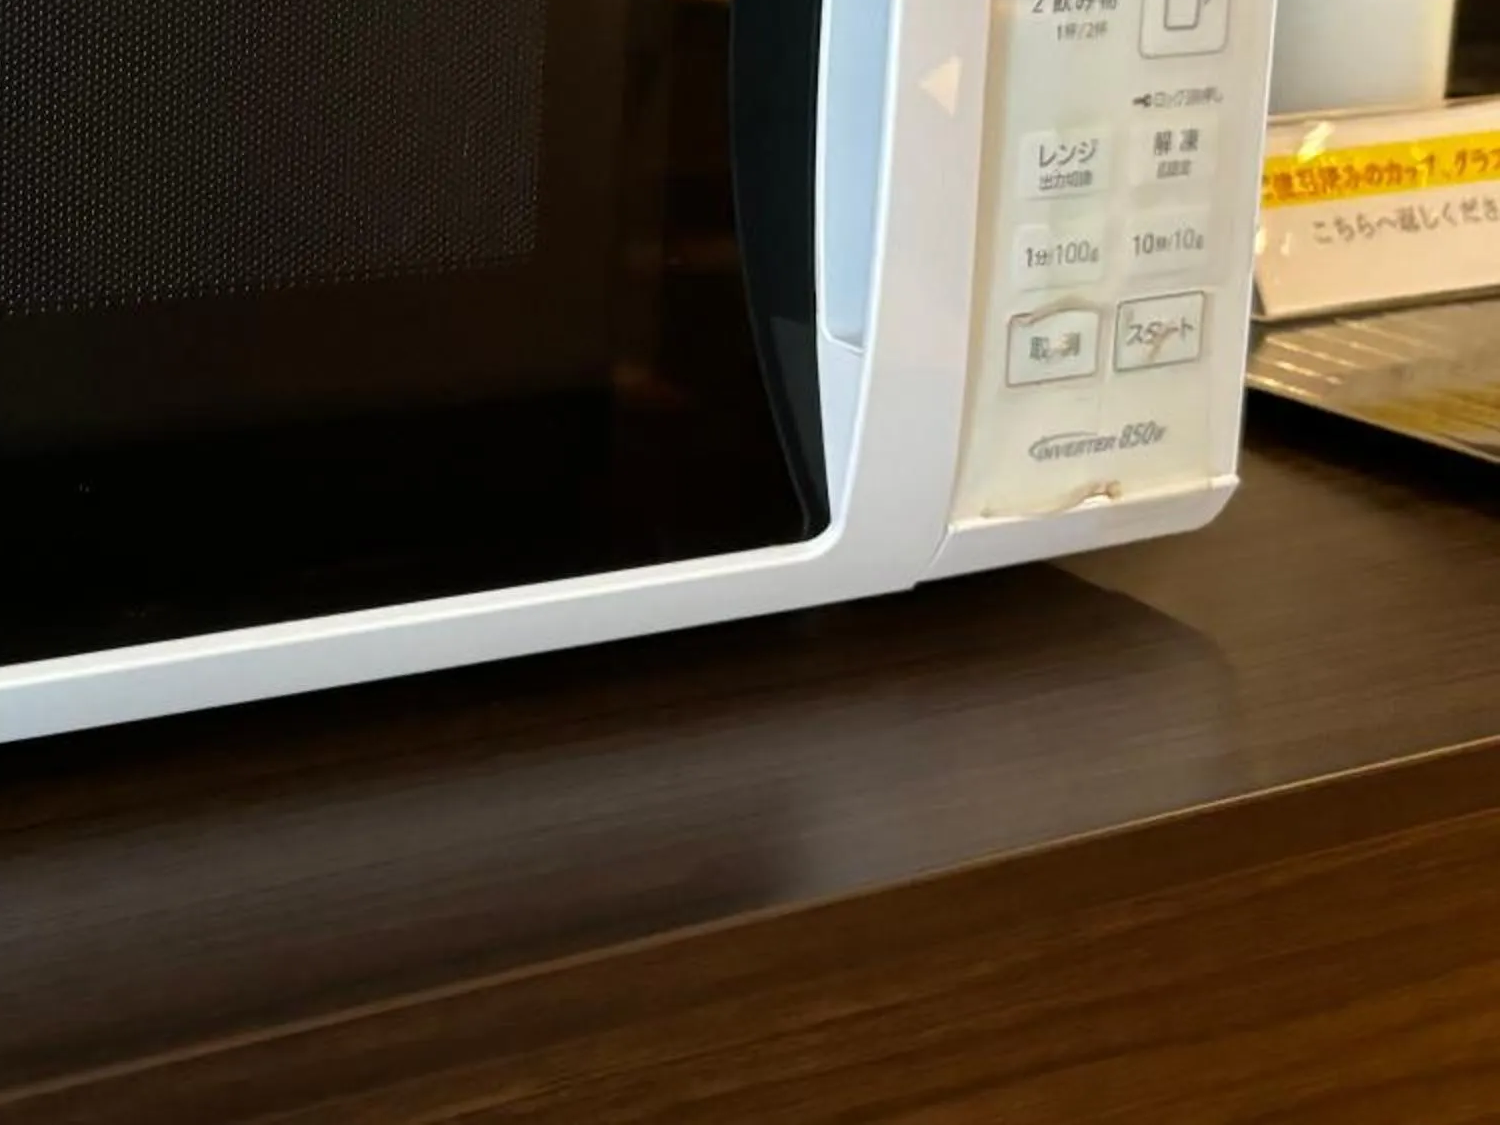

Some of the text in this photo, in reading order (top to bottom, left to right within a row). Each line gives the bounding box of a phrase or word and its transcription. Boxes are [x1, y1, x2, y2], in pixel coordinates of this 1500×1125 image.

[1039, 138, 1099, 168] レンジ
[1153, 128, 1199, 156] 解凍
[1033, 432, 1118, 462] INVERTER
